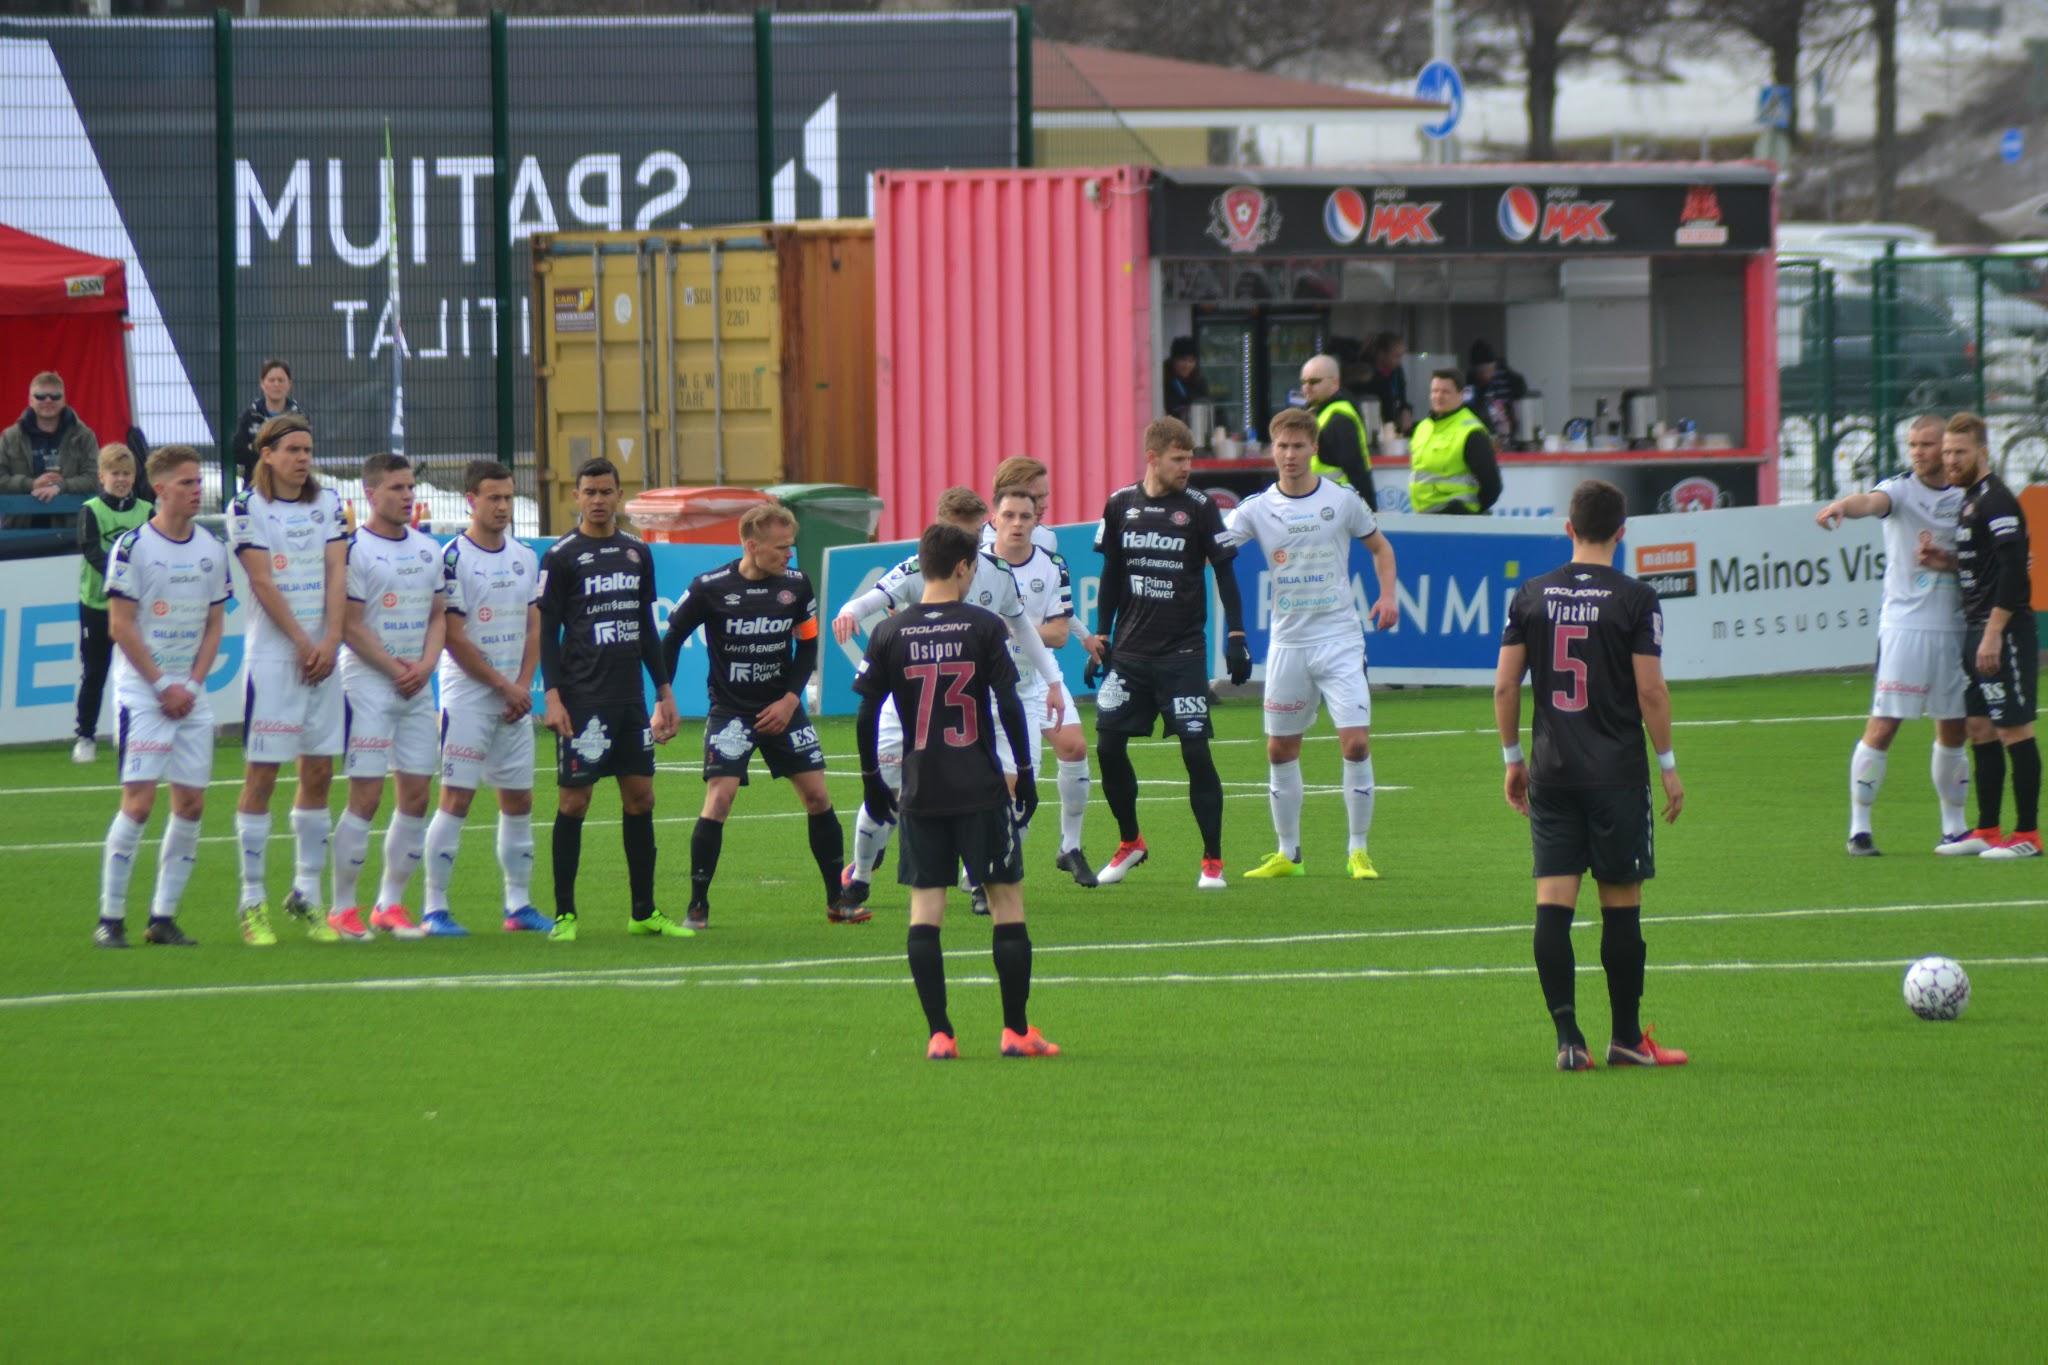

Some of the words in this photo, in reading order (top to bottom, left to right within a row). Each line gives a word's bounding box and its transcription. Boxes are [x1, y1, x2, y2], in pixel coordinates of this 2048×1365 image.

[1366, 202, 1444, 245] MAX
[1539, 201, 1617, 244] MAX
[1288, 524, 1321, 535] stadium
[1122, 531, 1186, 552] Halton
[1146, 558, 1184, 569] ENERGIA
[1642, 548, 1689, 567] mainos
[1144, 577, 1173, 589] Prima
[1304, 574, 1325, 584] LINE
[1710, 552, 1831, 595] Mainos
[1144, 588, 1175, 599] Power
[1543, 586, 1613, 598] TOOLPOINT
[1547, 600, 1599, 625] Vjatkin
[726, 617, 793, 635] Halton
[900, 623, 972, 636] TOOLPOINT
[1712, 607, 1884, 639] messuosa
[724, 643, 749, 652] LAHTI
[910, 640, 963, 663] Osipov
[1552, 624, 1589, 712] 5
[904, 661, 979, 751] 73
[1173, 696, 1207, 715] ESS
